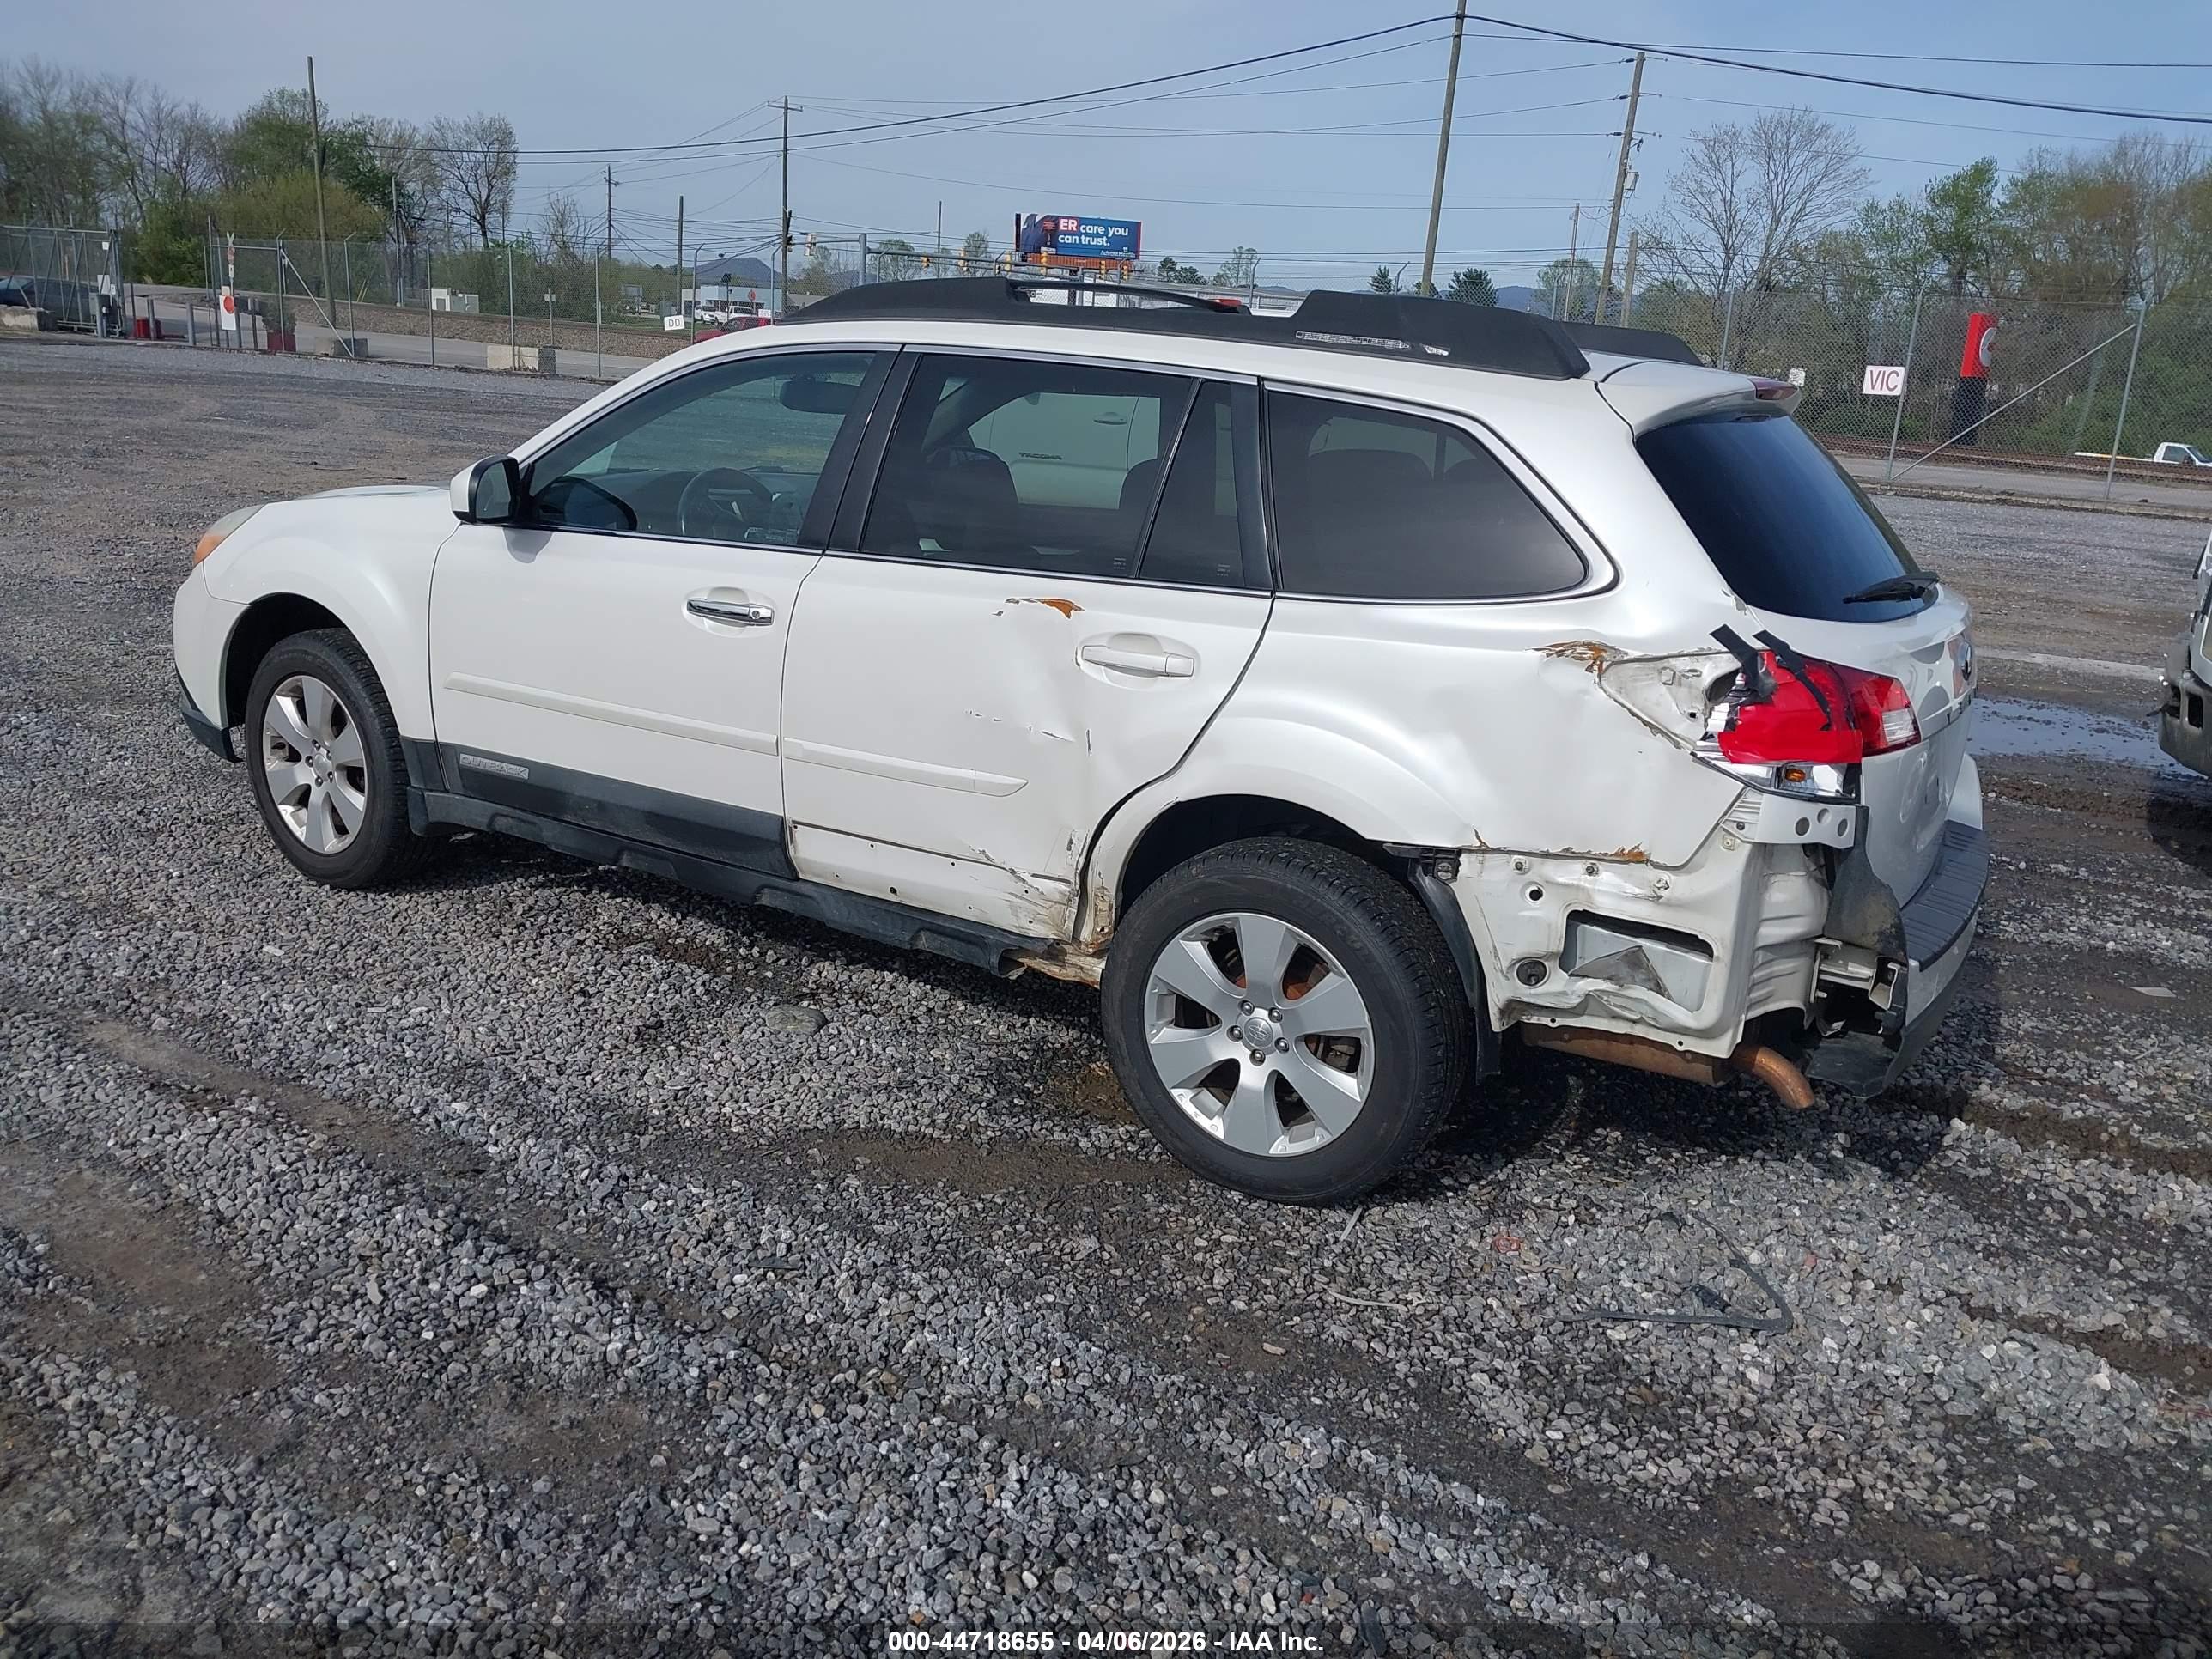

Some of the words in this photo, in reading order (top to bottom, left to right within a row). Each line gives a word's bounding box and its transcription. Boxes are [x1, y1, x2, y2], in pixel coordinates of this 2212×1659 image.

[1060, 218, 1078, 231] ER
[1079, 224, 1105, 234] care
[1108, 226, 1129, 237] you
[1058, 234, 1079, 244] can
[1080, 234, 1110, 246] trust.
[668, 318, 681, 327] DD
[1869, 369, 1899, 392] VIC
